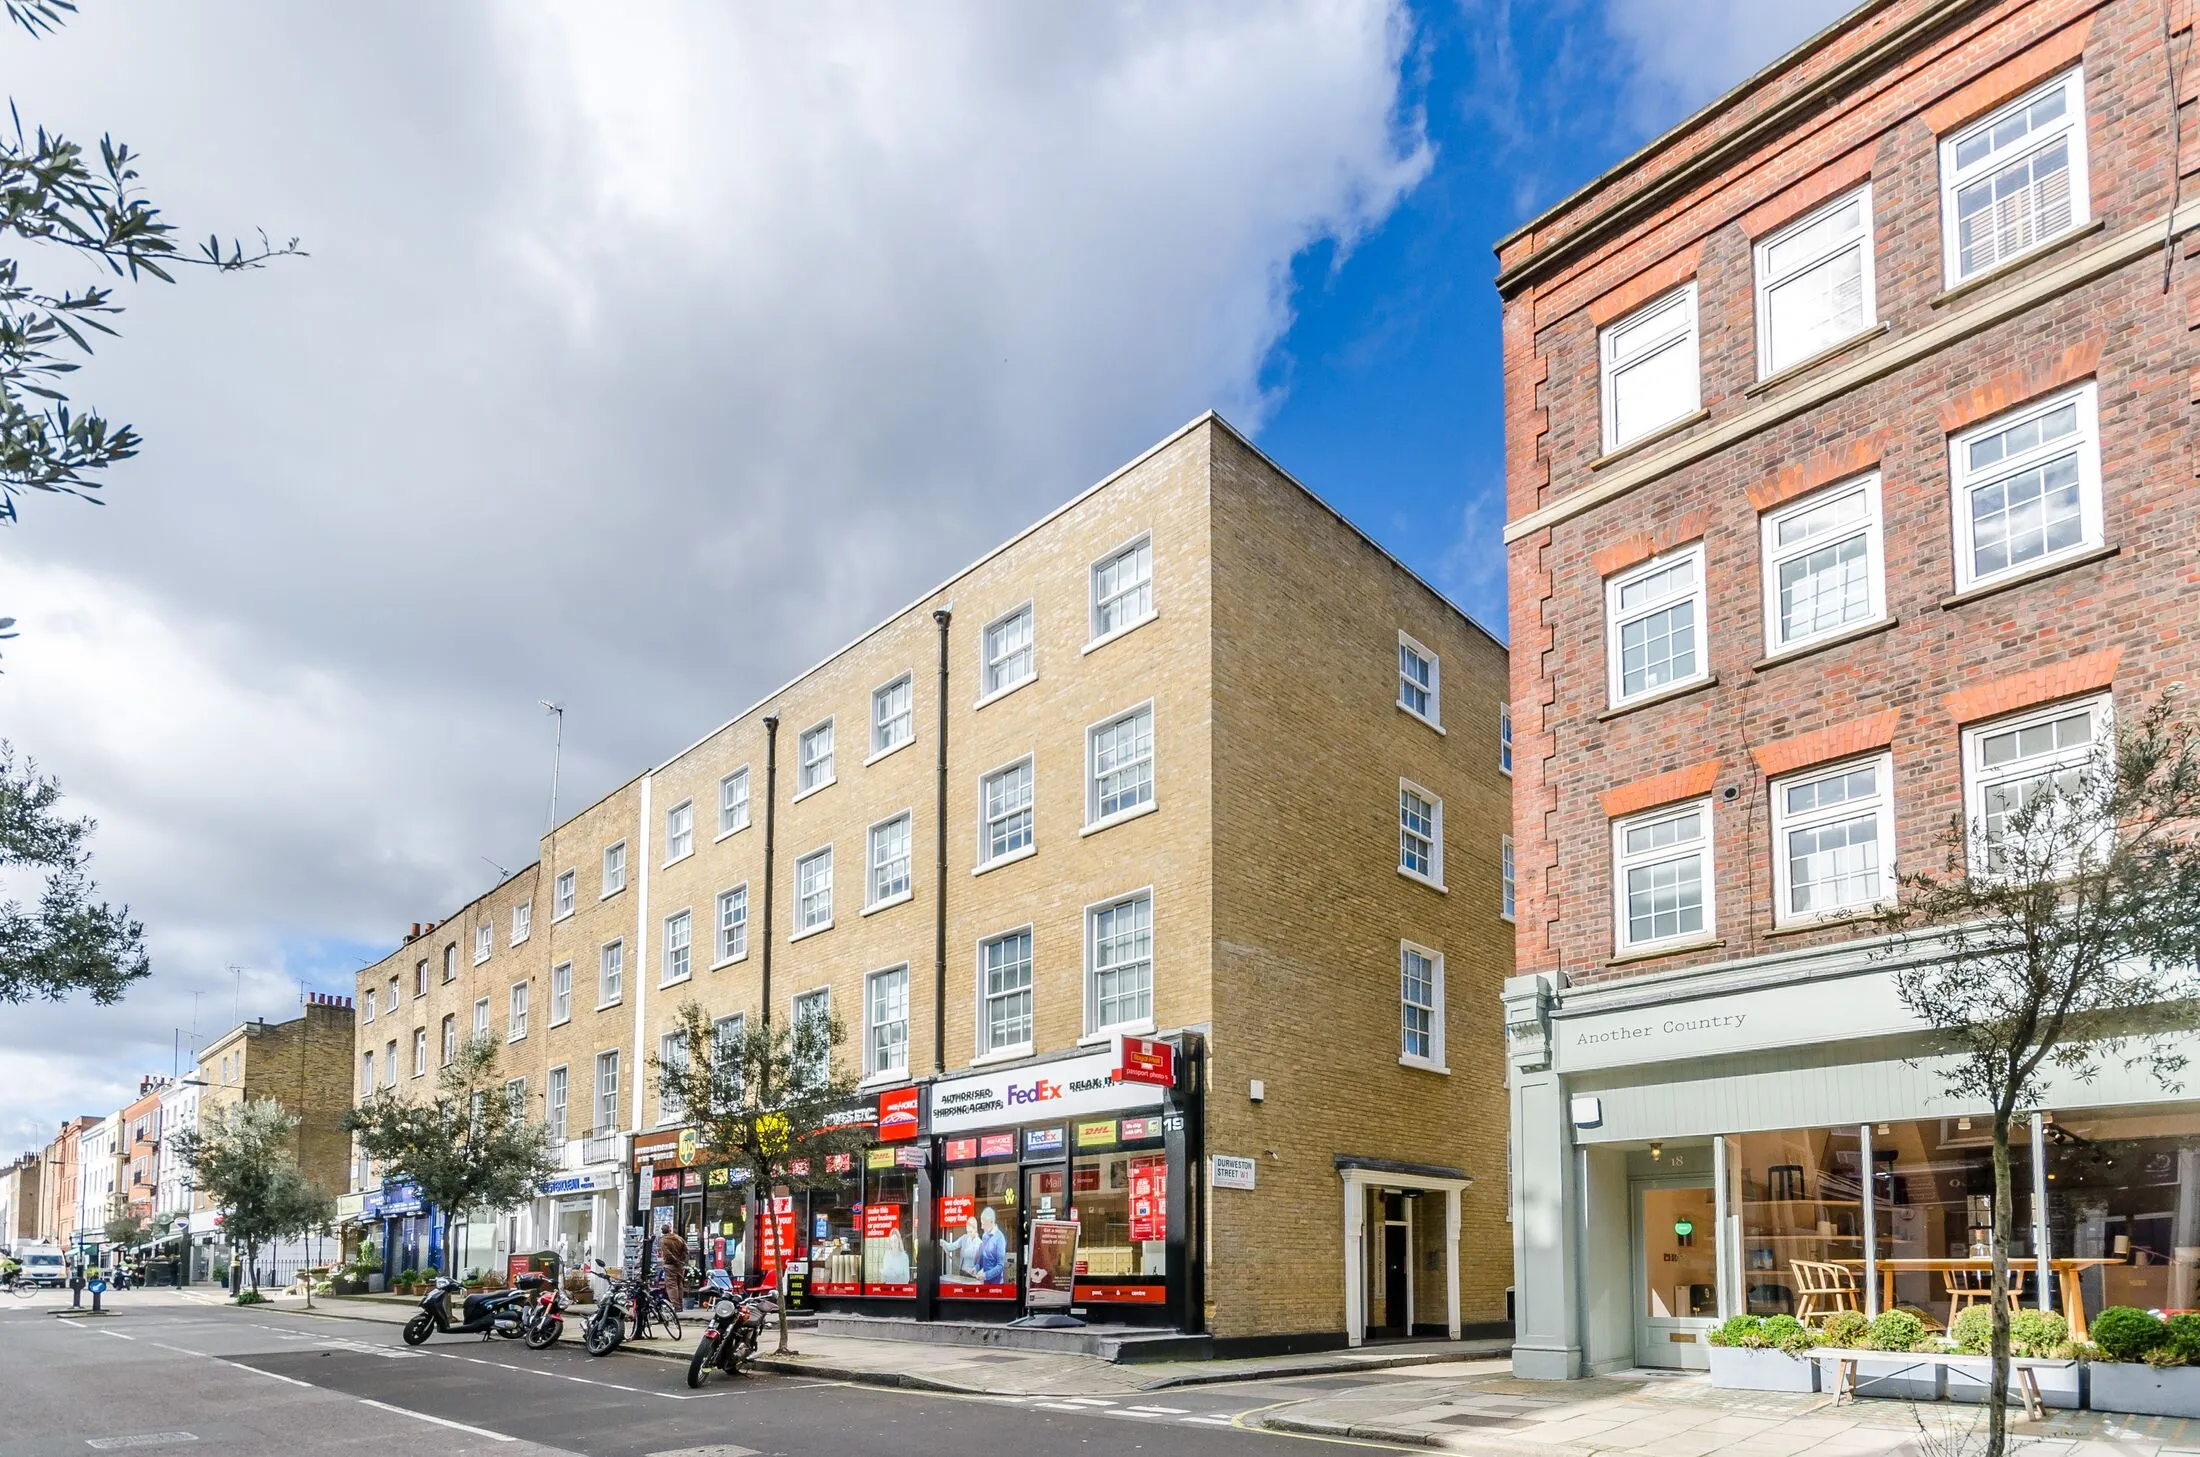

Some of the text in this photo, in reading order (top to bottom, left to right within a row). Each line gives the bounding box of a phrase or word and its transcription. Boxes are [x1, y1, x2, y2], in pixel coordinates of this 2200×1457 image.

[1577, 1014, 1747, 1045] Another Country
[1126, 1068, 1149, 1077] passport
[941, 1088, 993, 1104] AUTHORISED
[1007, 1079, 1062, 1106] FedEx
[932, 1099, 1004, 1119] SHIPPING AGENTS
[1084, 1126, 1109, 1136] DHL
[1163, 1117, 1184, 1132] 19
[1030, 1128, 1057, 1143] FedEx
[681, 1140, 695, 1160] ups
[1217, 1158, 1253, 1170] DURWESTON
[1671, 1155, 1684, 1167] 18
[1217, 1168, 1249, 1179] STREET W1
[1045, 1177, 1062, 1190] Mail
